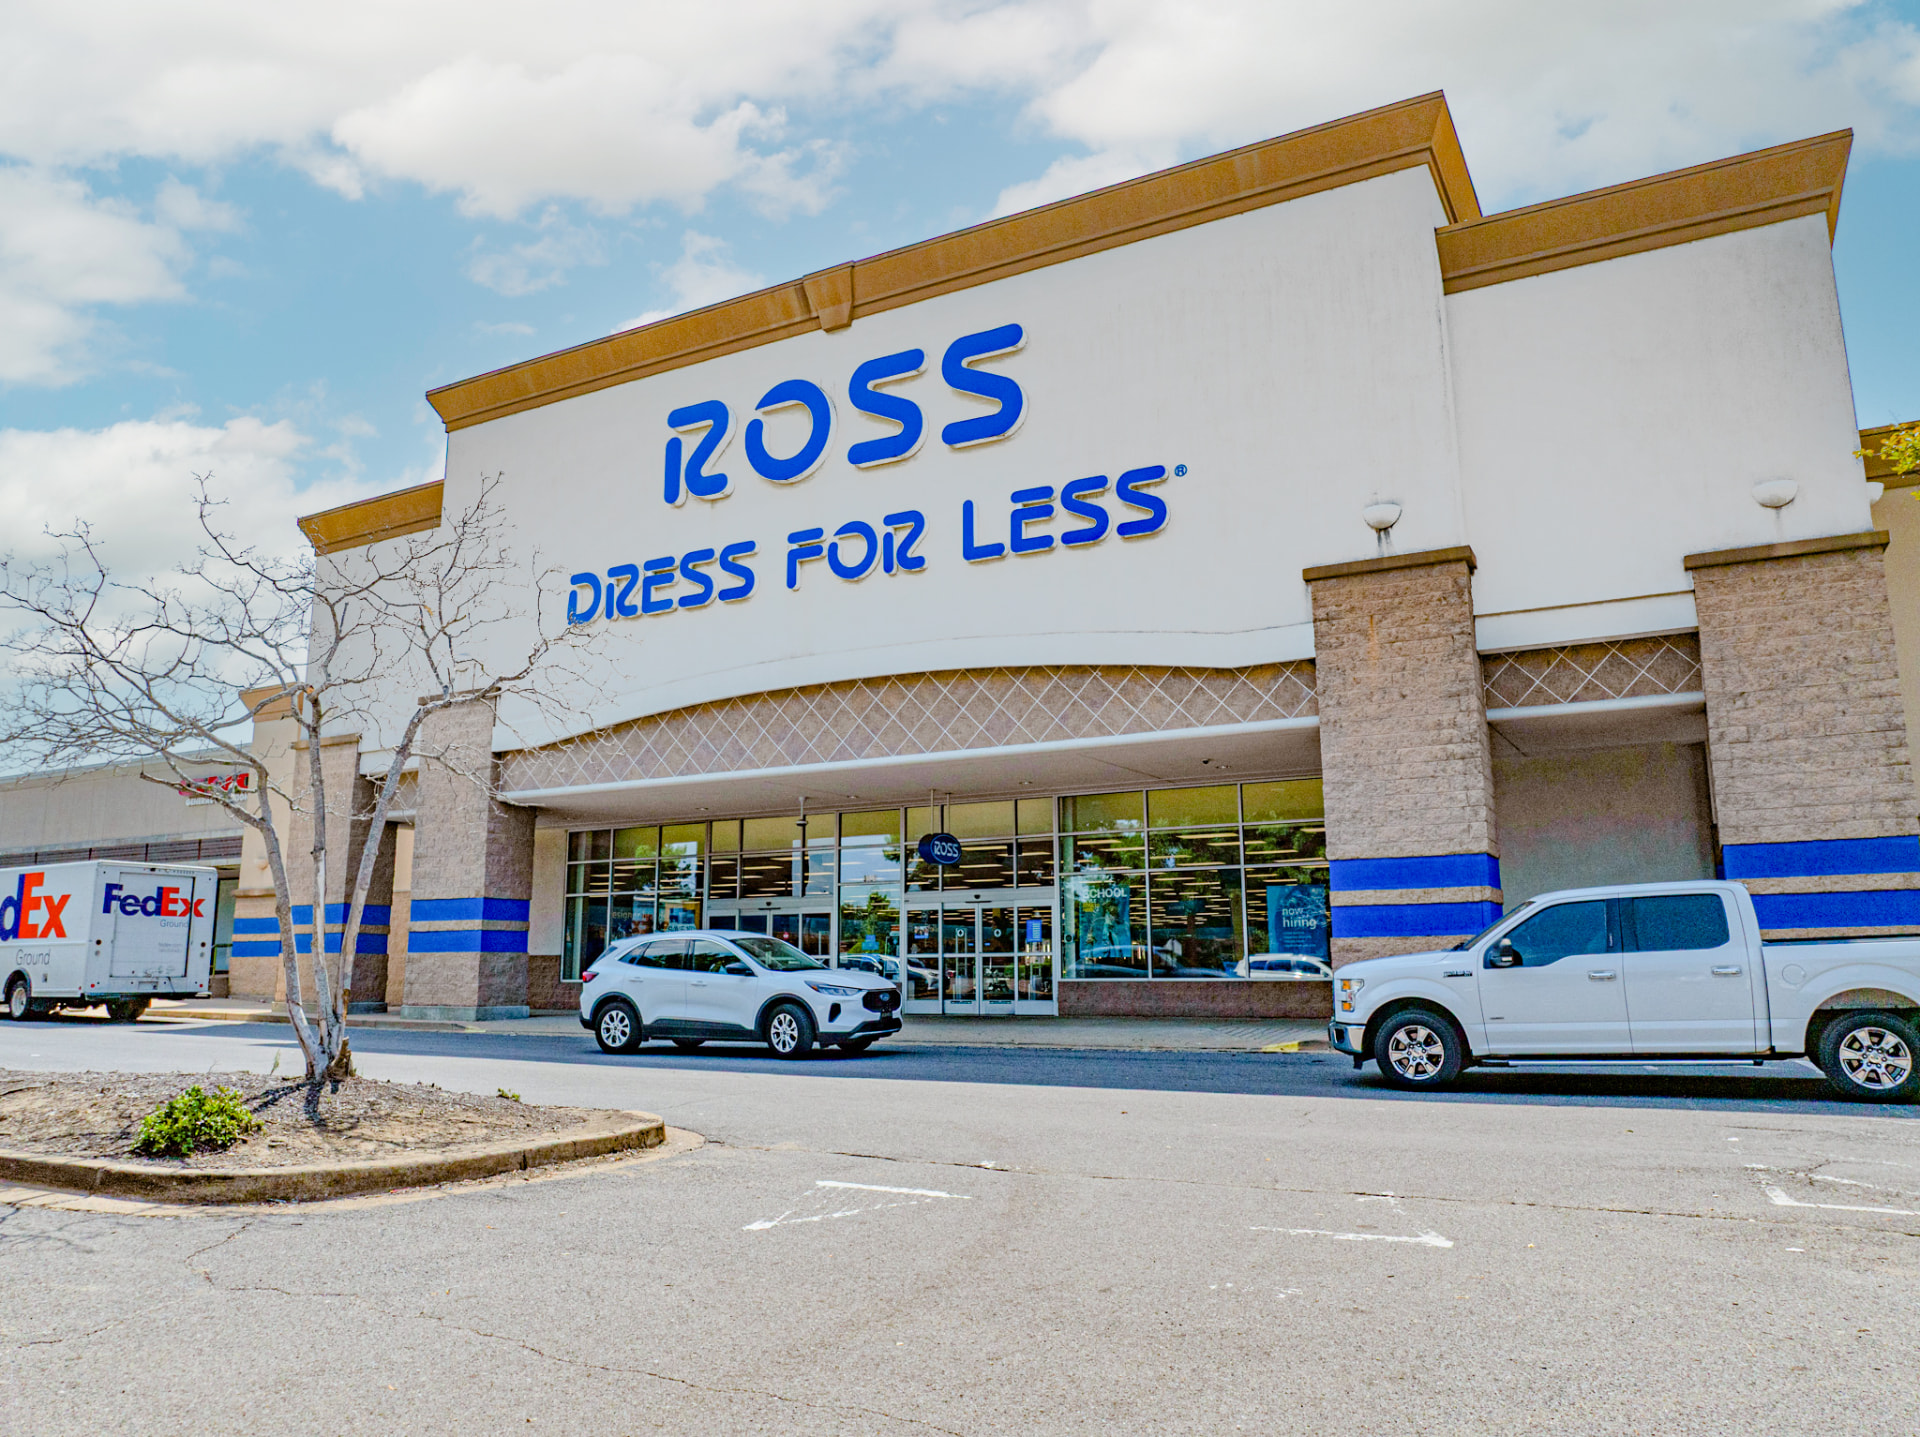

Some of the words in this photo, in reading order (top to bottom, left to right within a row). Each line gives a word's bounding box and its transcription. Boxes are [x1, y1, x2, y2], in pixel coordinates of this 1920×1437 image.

[664, 323, 1025, 505] ROSS
[566, 540, 757, 626] DRESS
[787, 509, 926, 590] FOR
[933, 840, 959, 858] ROSS
[102, 882, 206, 918] FedEx
[1282, 907, 1304, 916] now
[1282, 916, 1317, 930] hiring
[16, 948, 51, 966] Ground
